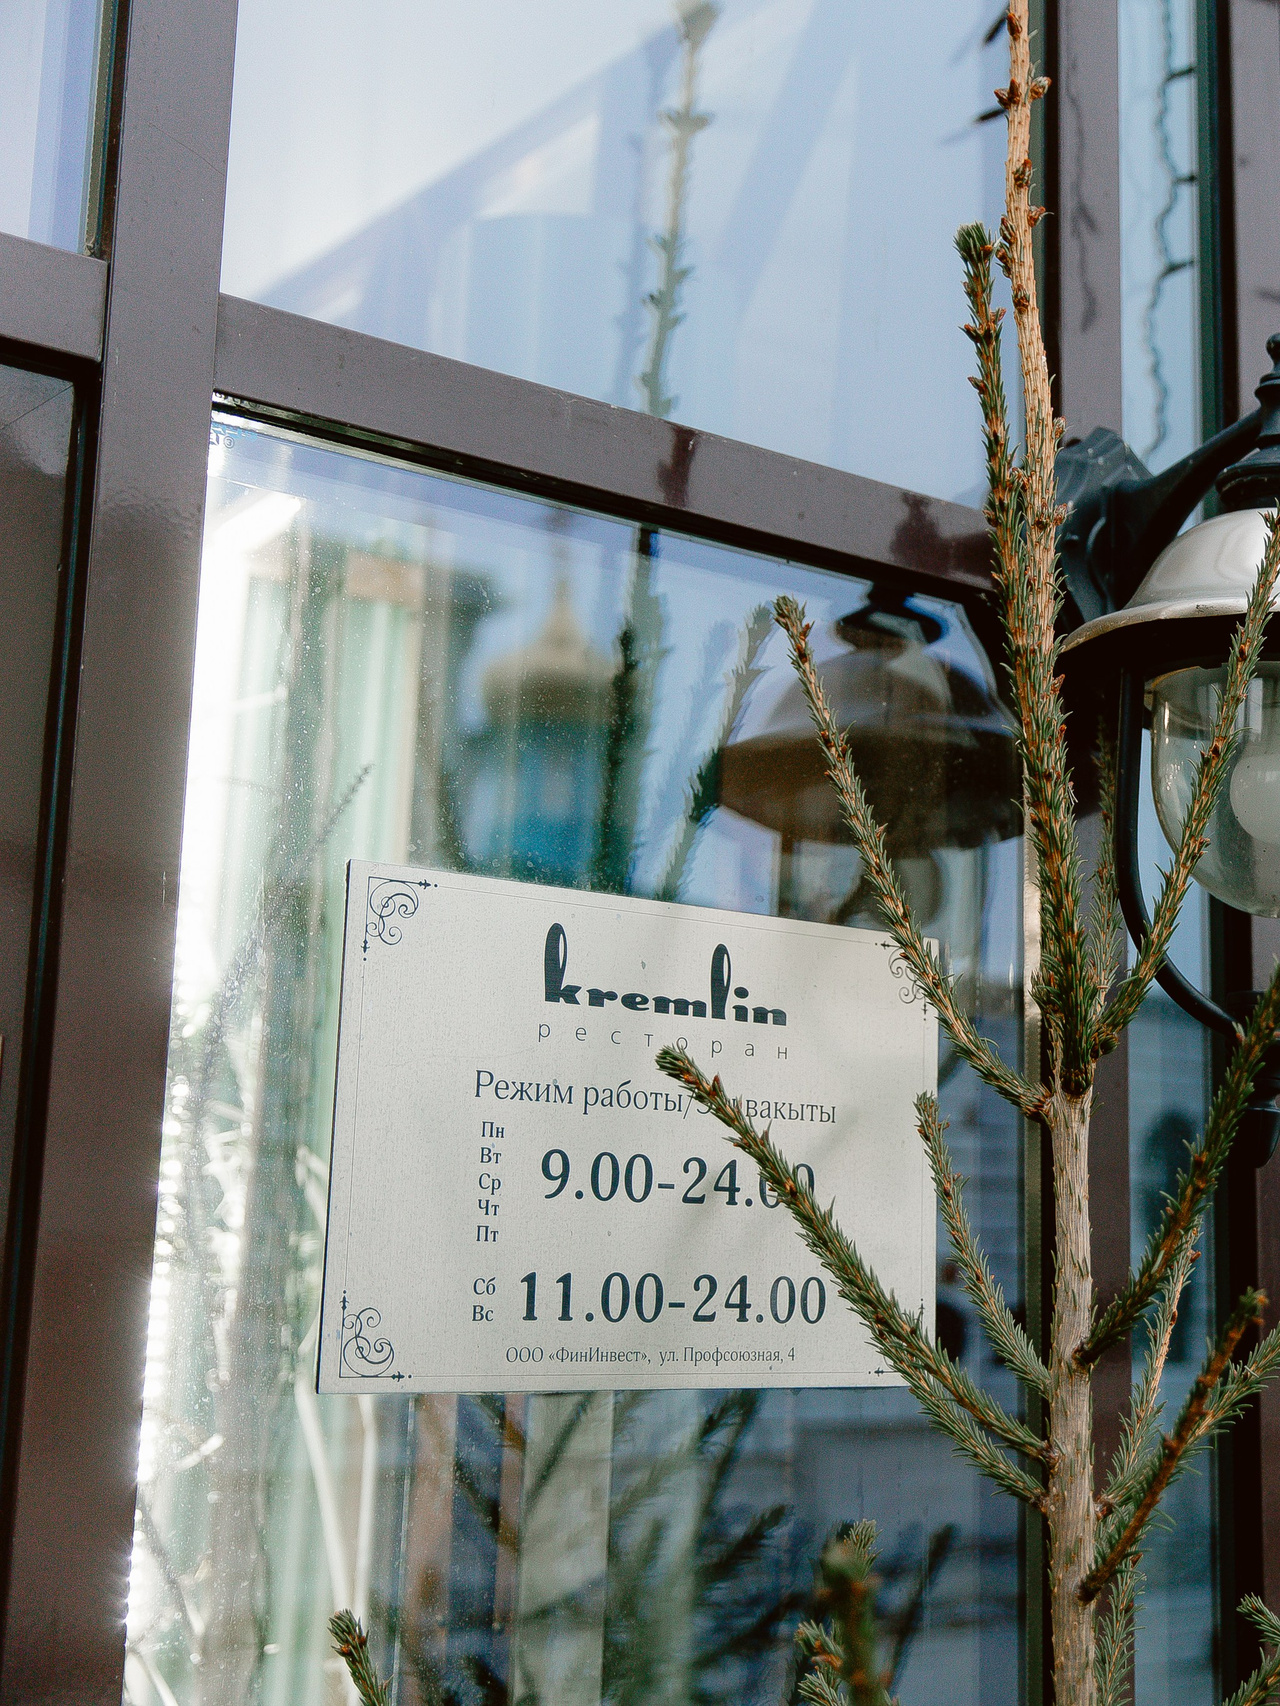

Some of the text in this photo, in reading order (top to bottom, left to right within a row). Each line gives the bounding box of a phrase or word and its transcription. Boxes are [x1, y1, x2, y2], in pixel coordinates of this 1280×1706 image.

[544, 922, 788, 1027] kremlin
[538, 1021, 788, 1060] ресторан
[474, 1069, 574, 1104] Режим
[745, 1099, 837, 1124] вакыты
[481, 1120, 505, 1138] Пн
[480, 1146, 502, 1164] Вт
[478, 1172, 502, 1195] Ср
[477, 1199, 500, 1216] Чт
[476, 1225, 499, 1242] Пт
[472, 1276, 497, 1296] Сб
[519, 1271, 827, 1325] 11.00-24.00
[471, 1304, 494, 1322] Вс
[505, 1346, 796, 1367] ООО «ФинИнвест», ул. Профсоюзная, 4
